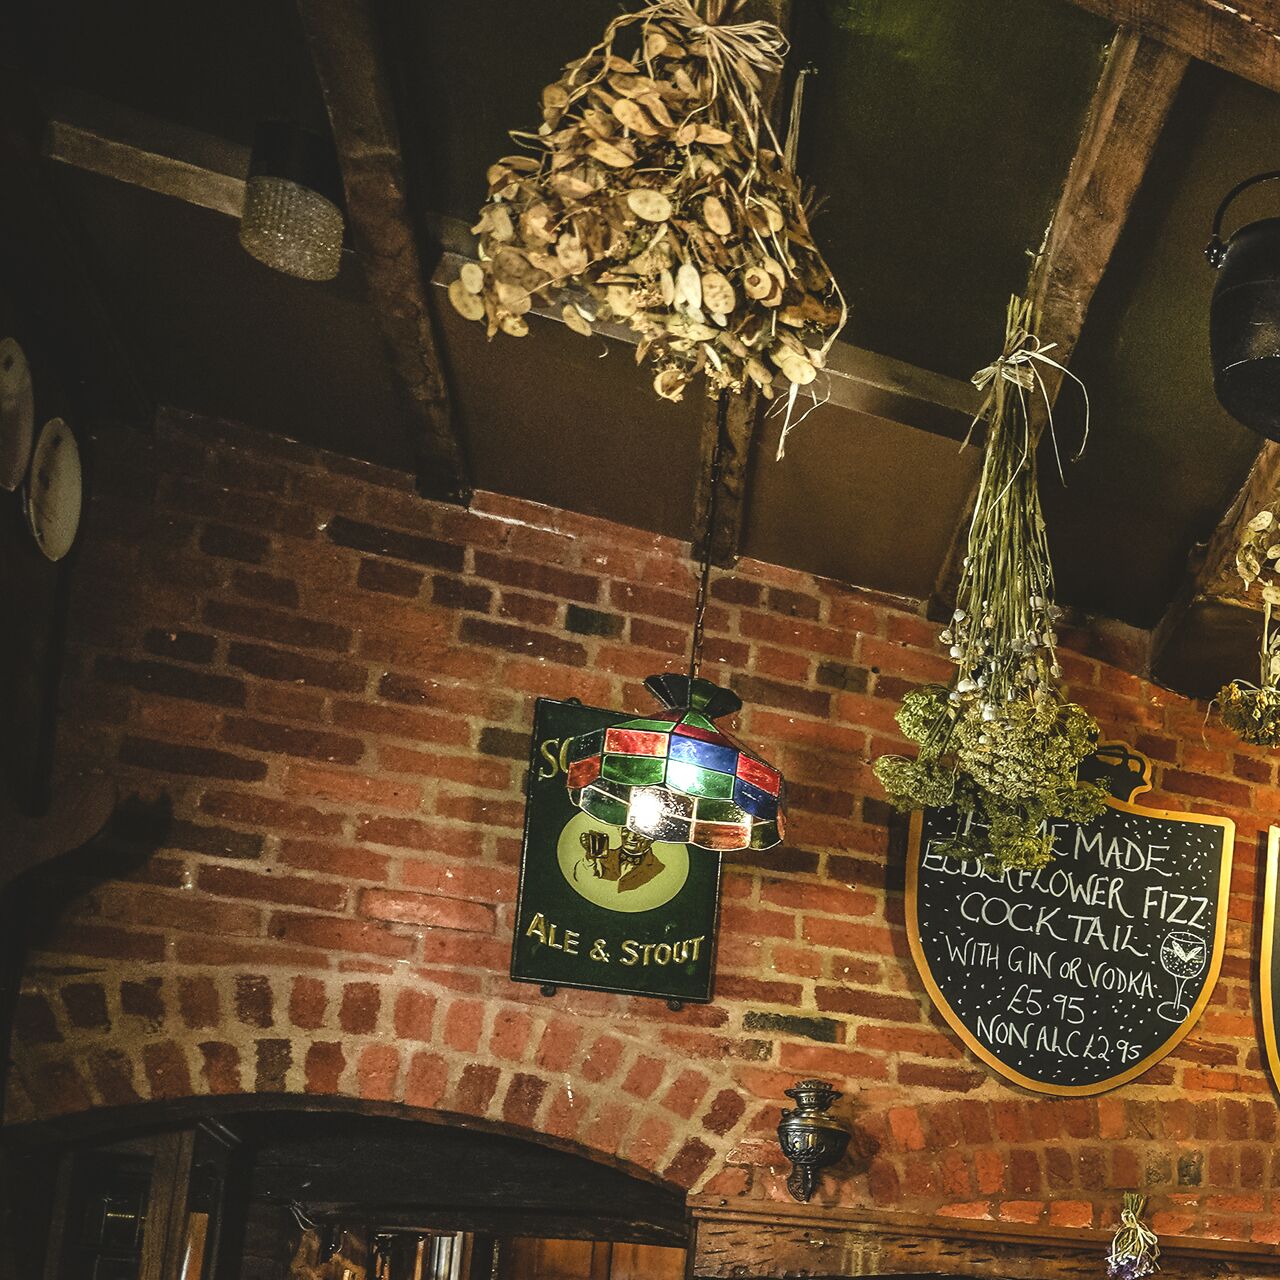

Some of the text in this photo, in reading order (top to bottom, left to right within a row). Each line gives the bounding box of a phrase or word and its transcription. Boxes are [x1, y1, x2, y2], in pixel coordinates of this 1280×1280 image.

[1142, 886, 1209, 929] FIZZ
[526, 912, 705, 967] ALE & STOUT
[945, 935, 1154, 998] WITH GIN OR VODKA
[977, 1015, 1034, 1048] NON
